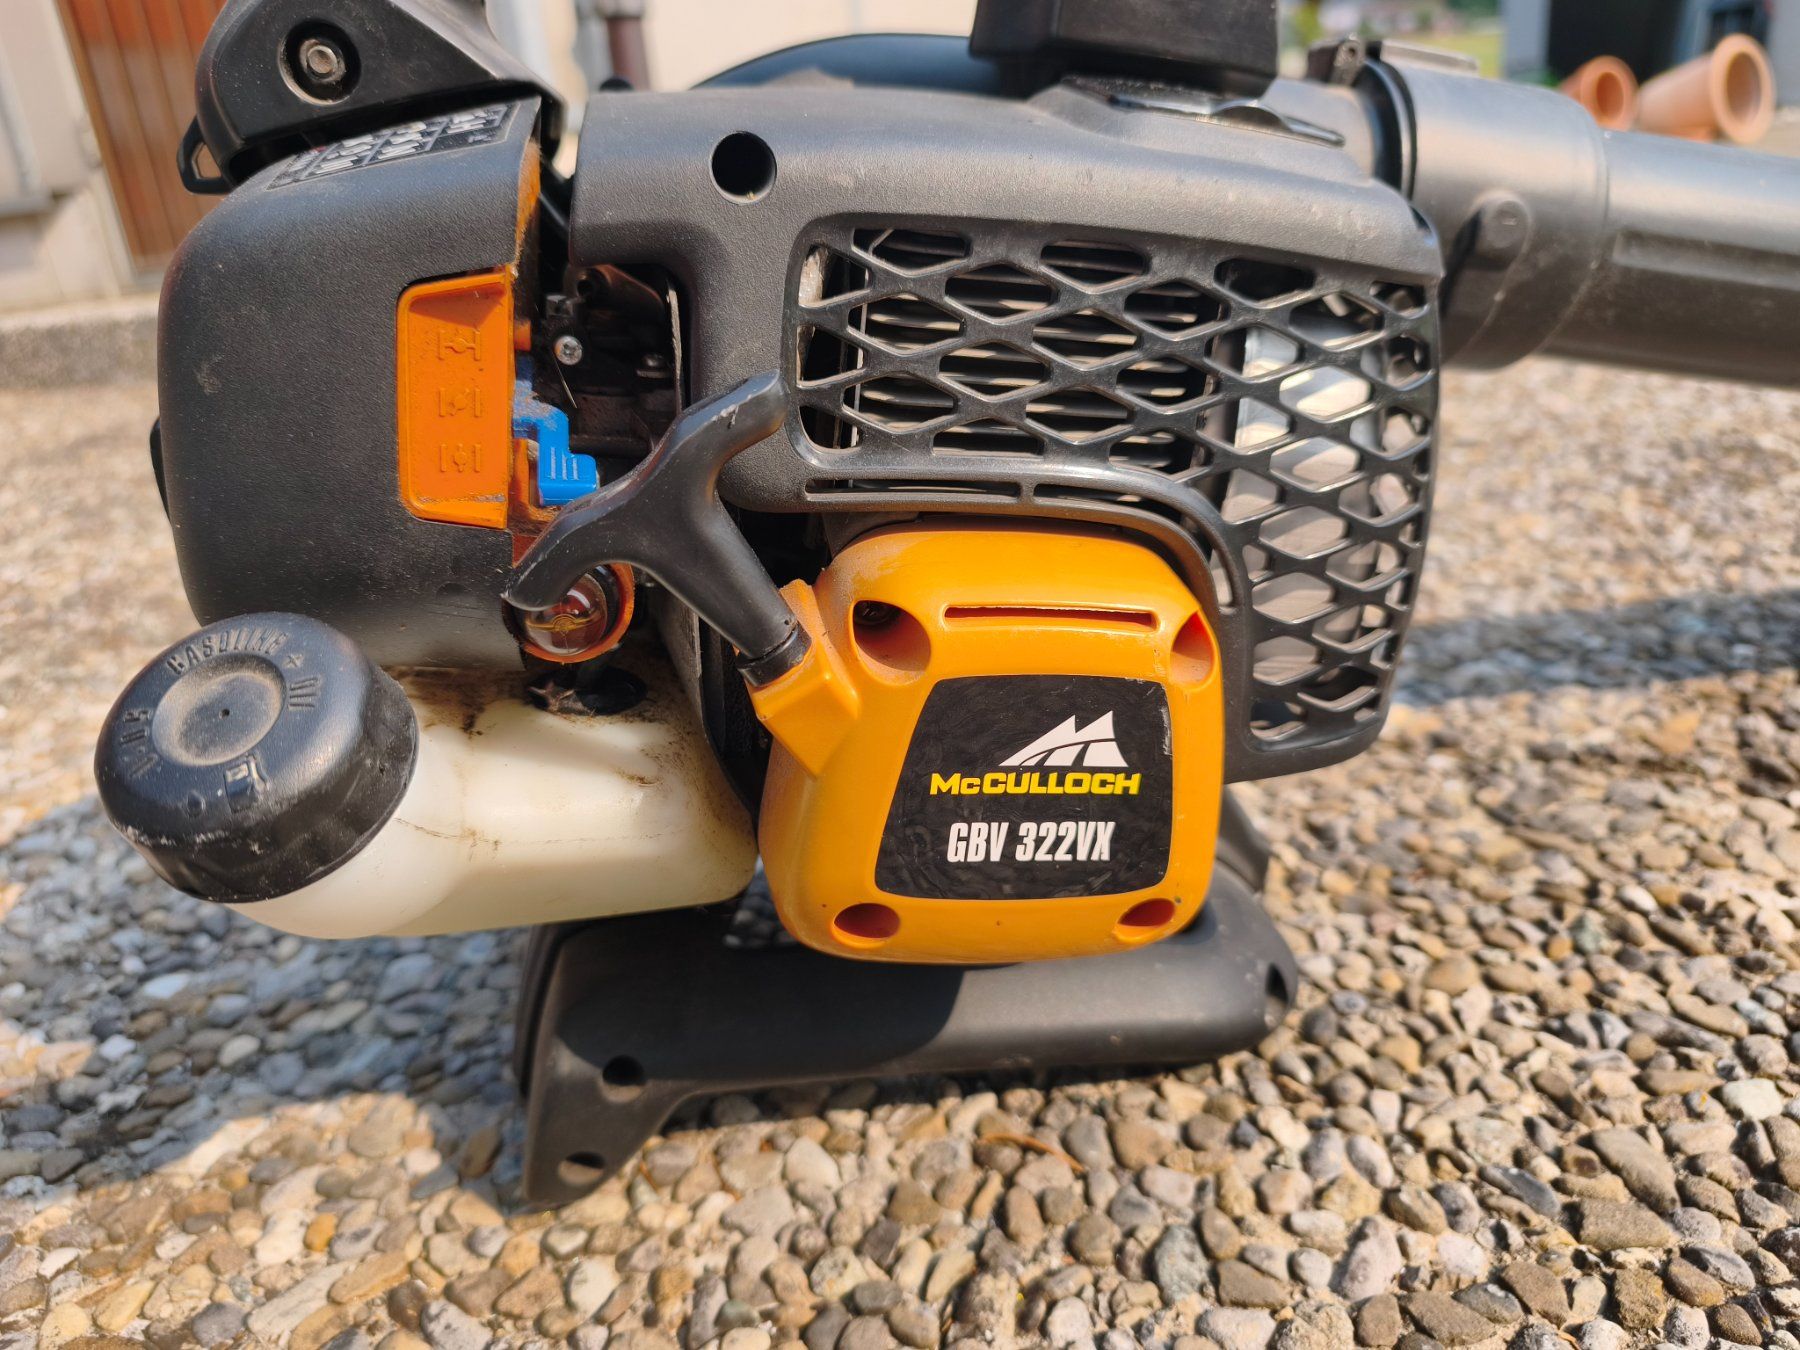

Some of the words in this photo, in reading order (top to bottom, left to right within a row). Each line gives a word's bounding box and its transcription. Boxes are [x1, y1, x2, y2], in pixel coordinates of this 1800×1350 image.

[167, 628, 287, 674] GASOLINE
[930, 773, 1141, 795] McCULLOCH
[948, 822, 1009, 861] GBV
[1016, 822, 1115, 861] 322VX
